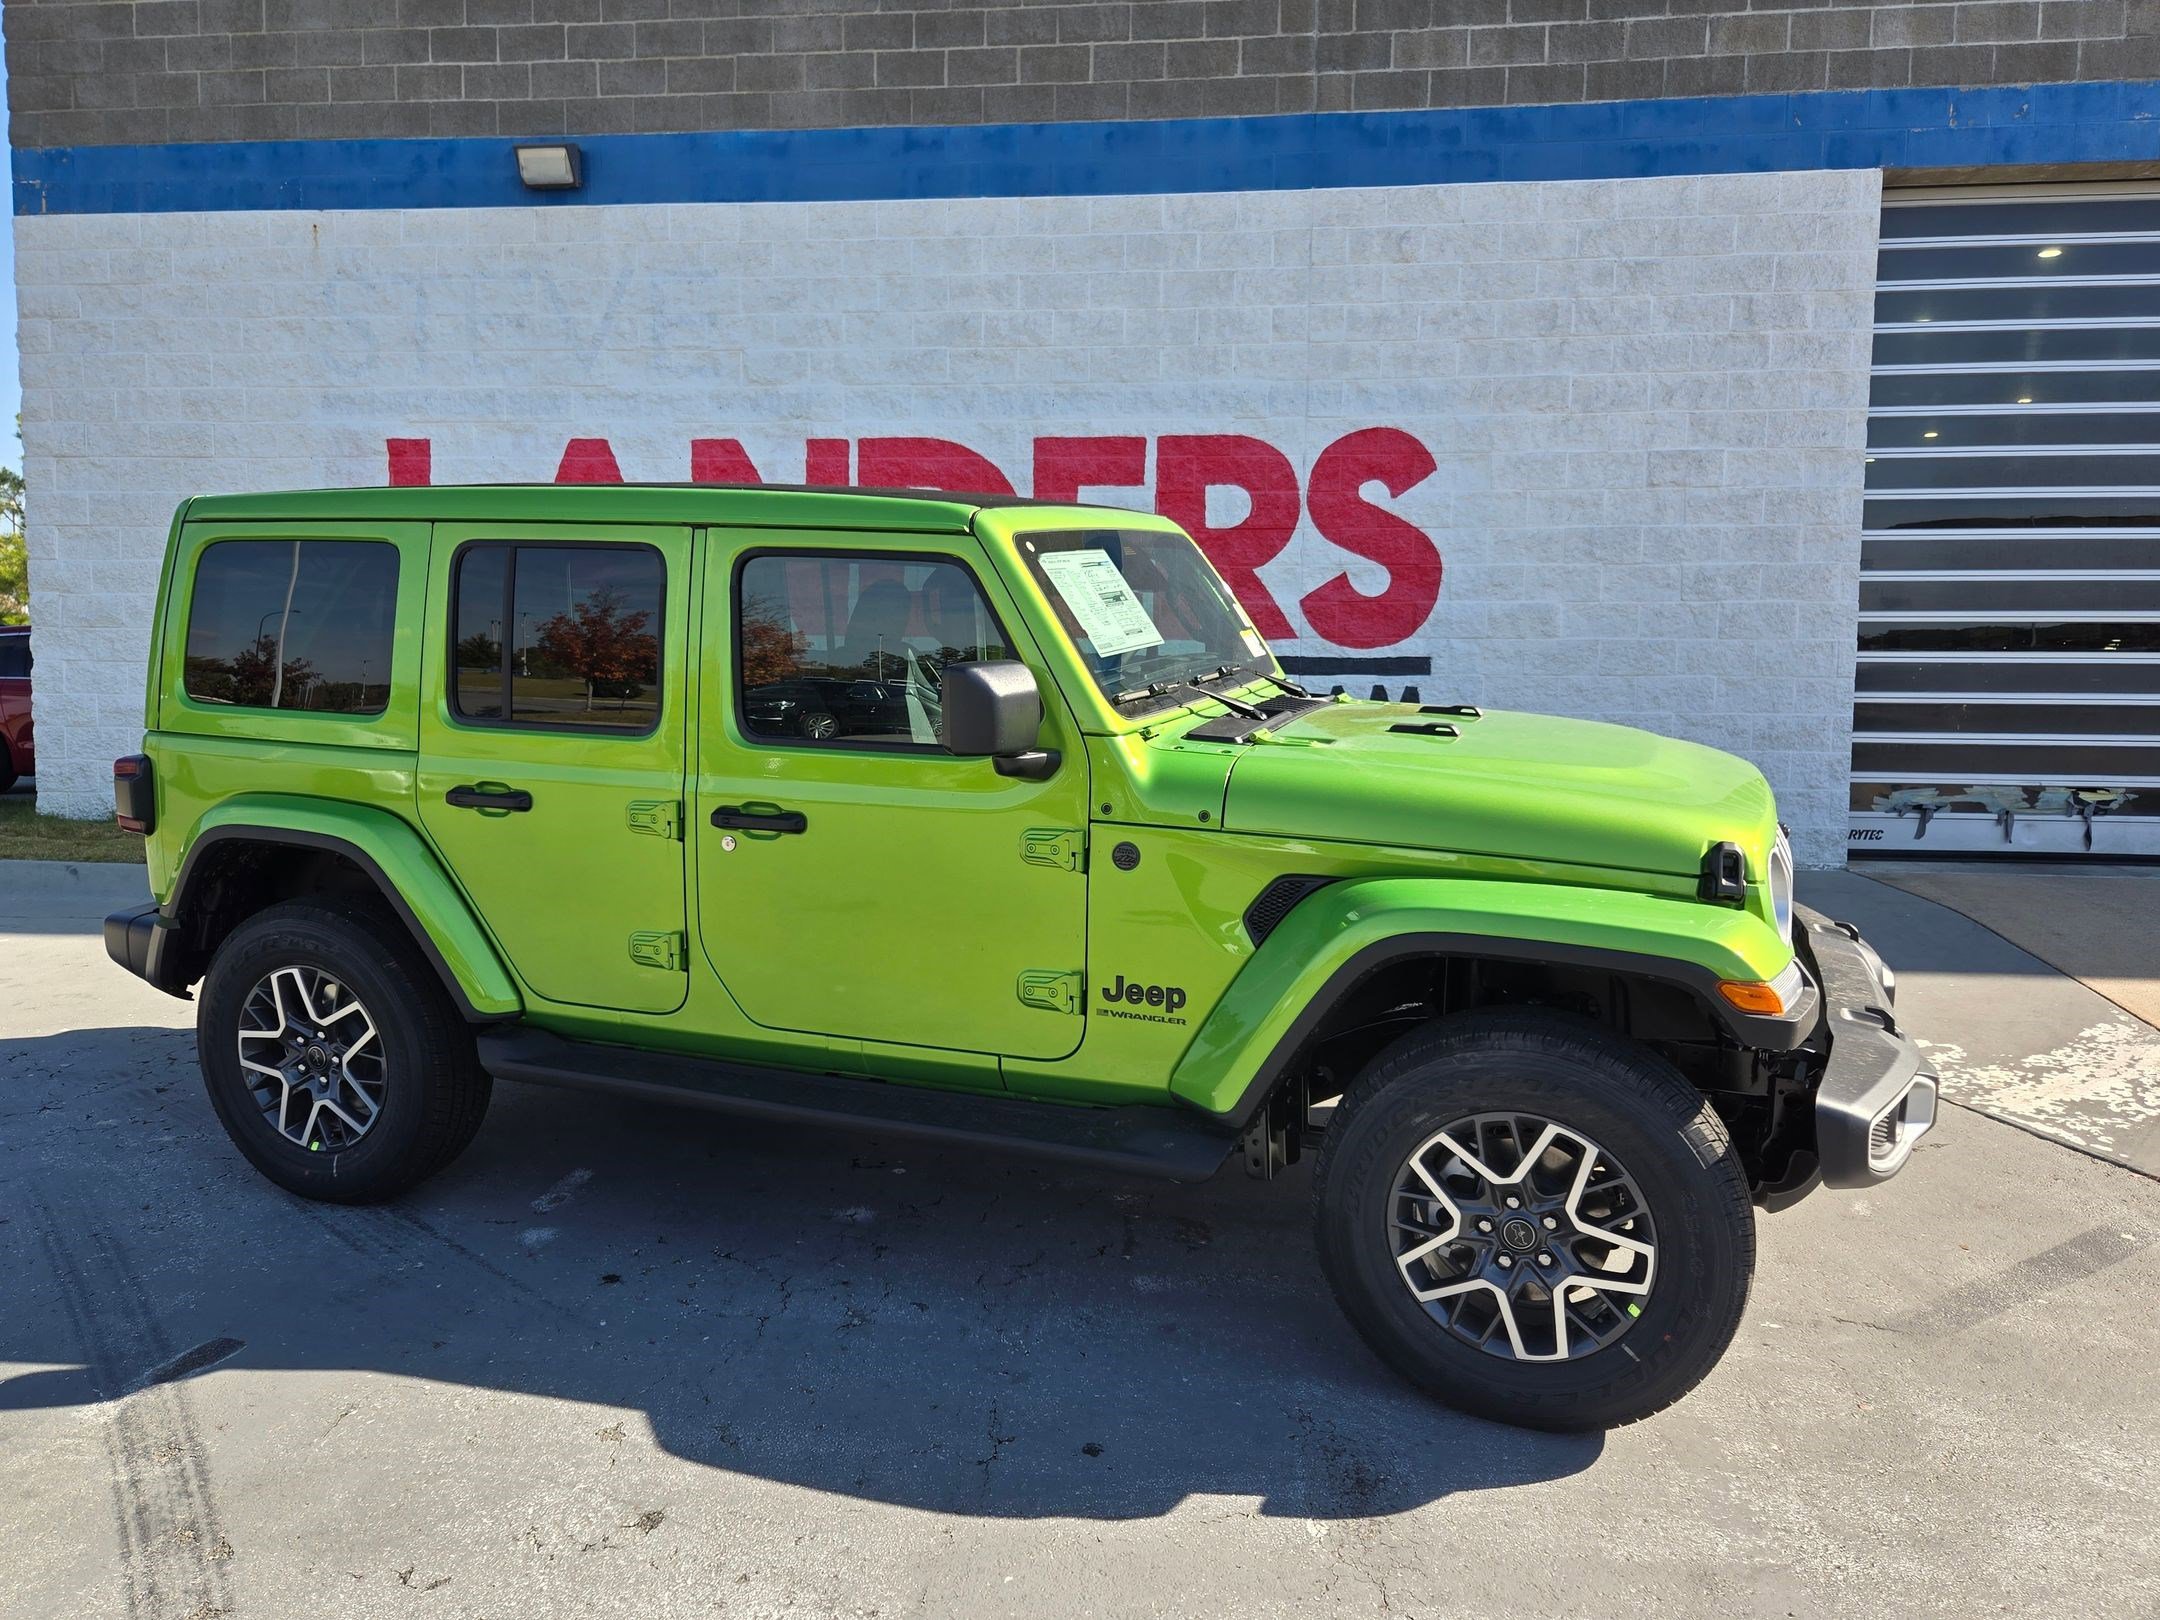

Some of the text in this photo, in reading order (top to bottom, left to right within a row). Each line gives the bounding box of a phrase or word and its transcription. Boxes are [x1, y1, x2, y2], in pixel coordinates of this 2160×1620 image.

[1848, 829, 1885, 841] RYTEC
[1102, 975, 1187, 1014] Jeep
[1109, 1010, 1187, 1026] WRANGLER
